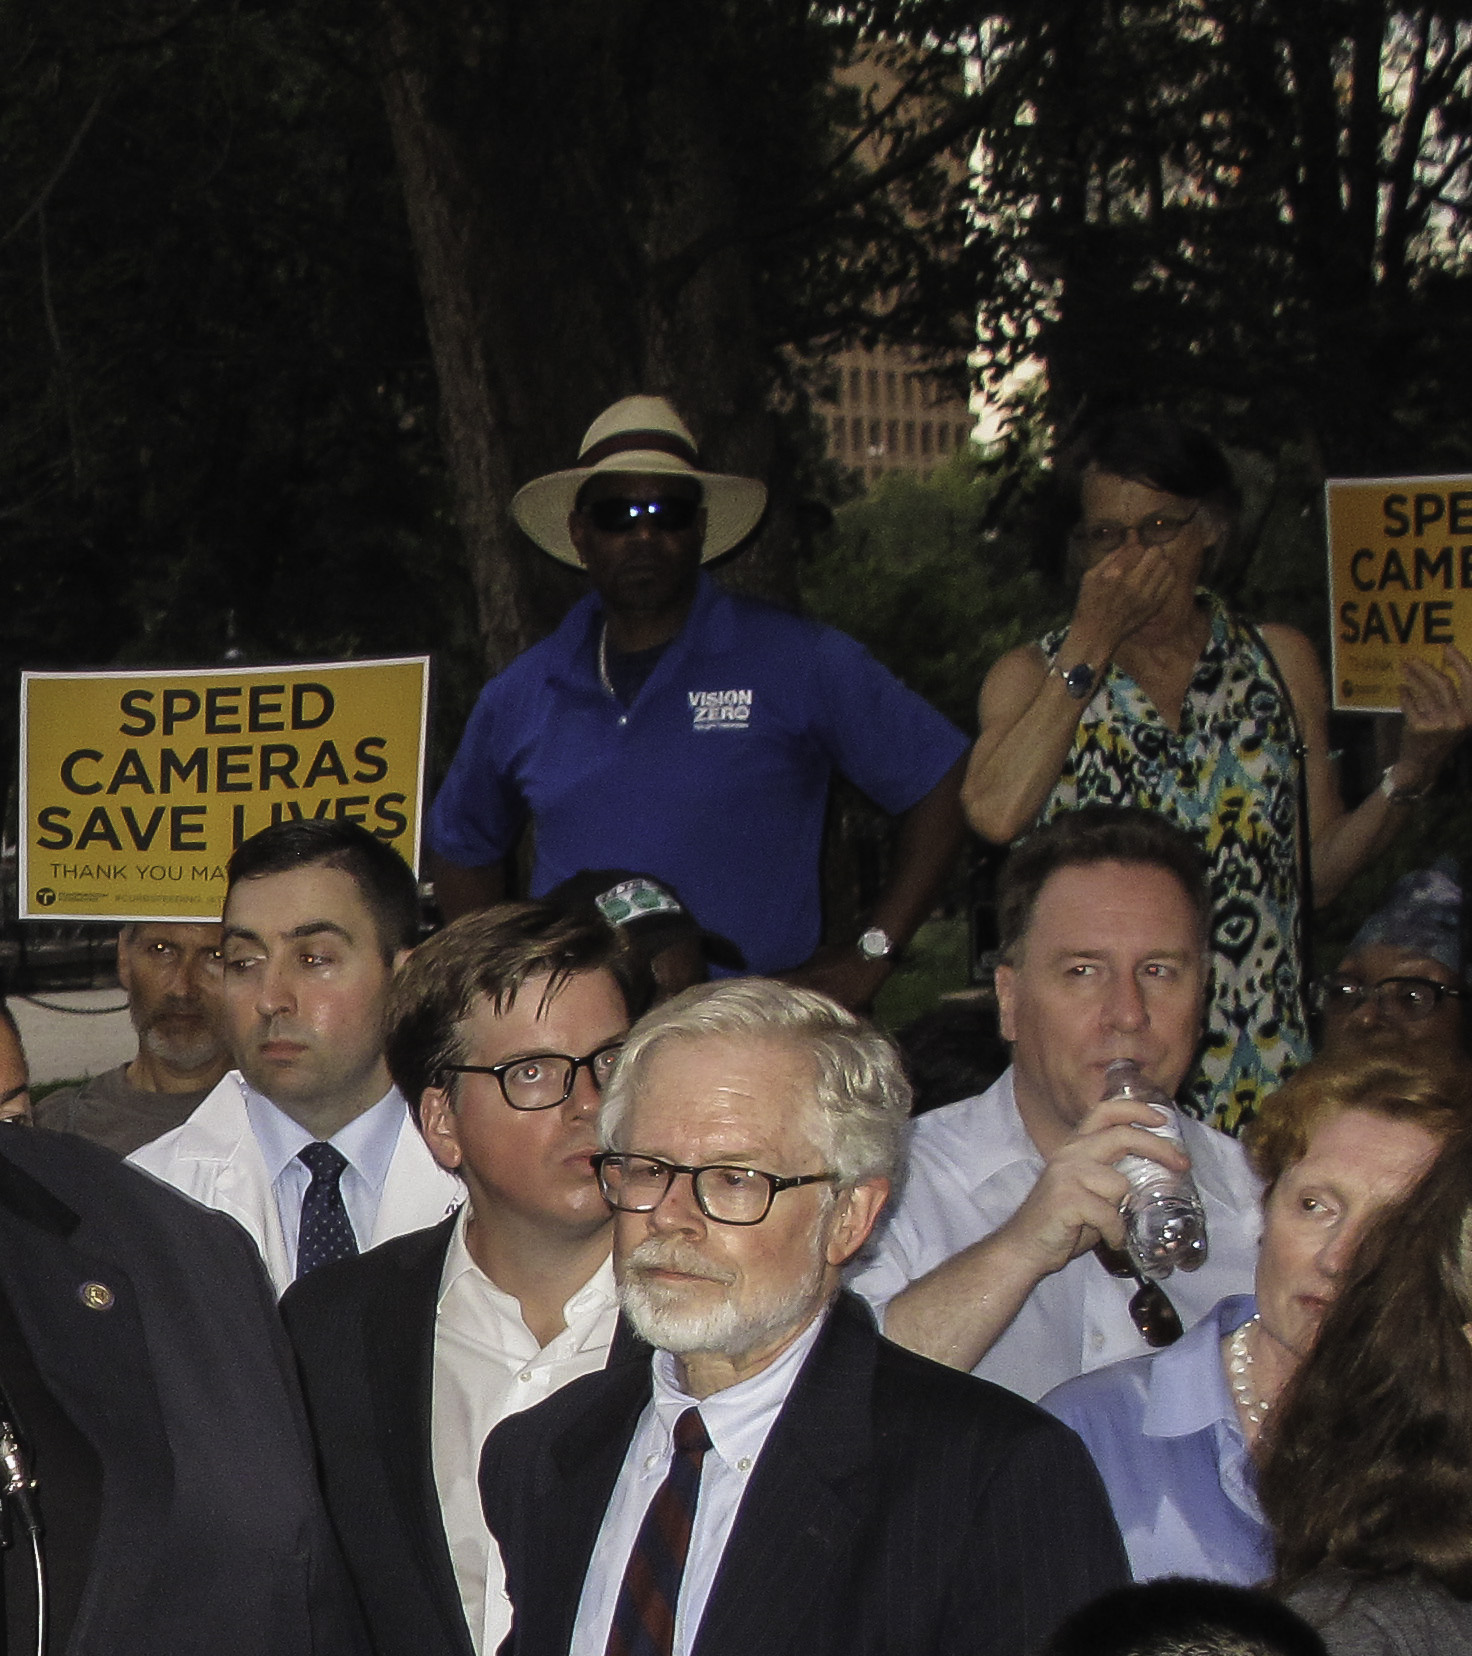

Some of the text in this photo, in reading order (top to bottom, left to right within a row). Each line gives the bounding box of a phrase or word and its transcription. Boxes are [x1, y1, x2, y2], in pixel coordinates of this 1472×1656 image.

[1340, 601, 1454, 645] SAVE
[119, 683, 335, 737] SPEED
[688, 689, 753, 706] VISION
[694, 704, 750, 723] ZERO
[60, 737, 389, 796] CAMERAS
[36, 805, 208, 852] SAVE
[50, 863, 230, 882] THANK YOU MA
